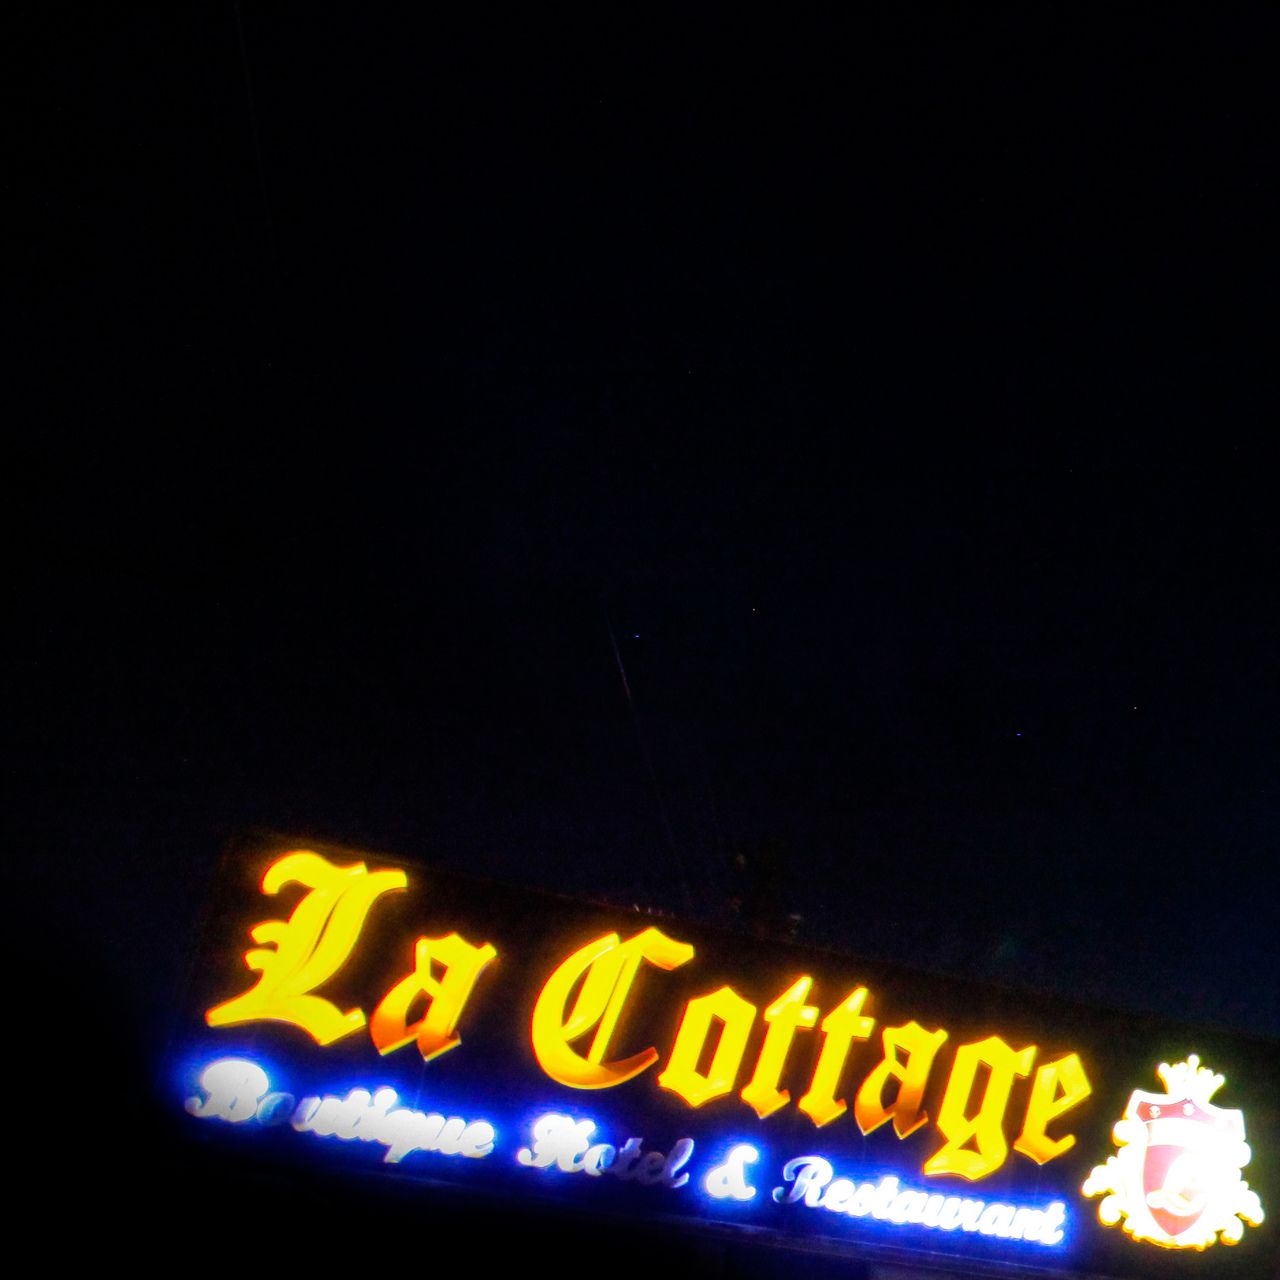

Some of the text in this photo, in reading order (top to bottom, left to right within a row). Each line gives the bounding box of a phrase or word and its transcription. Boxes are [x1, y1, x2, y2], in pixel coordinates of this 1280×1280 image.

[205, 850, 1092, 1180] La Cottage
[517, 1114, 695, 1188] Hotel
[706, 1145, 759, 1199] &
[772, 1156, 1065, 1245] Restaurant
